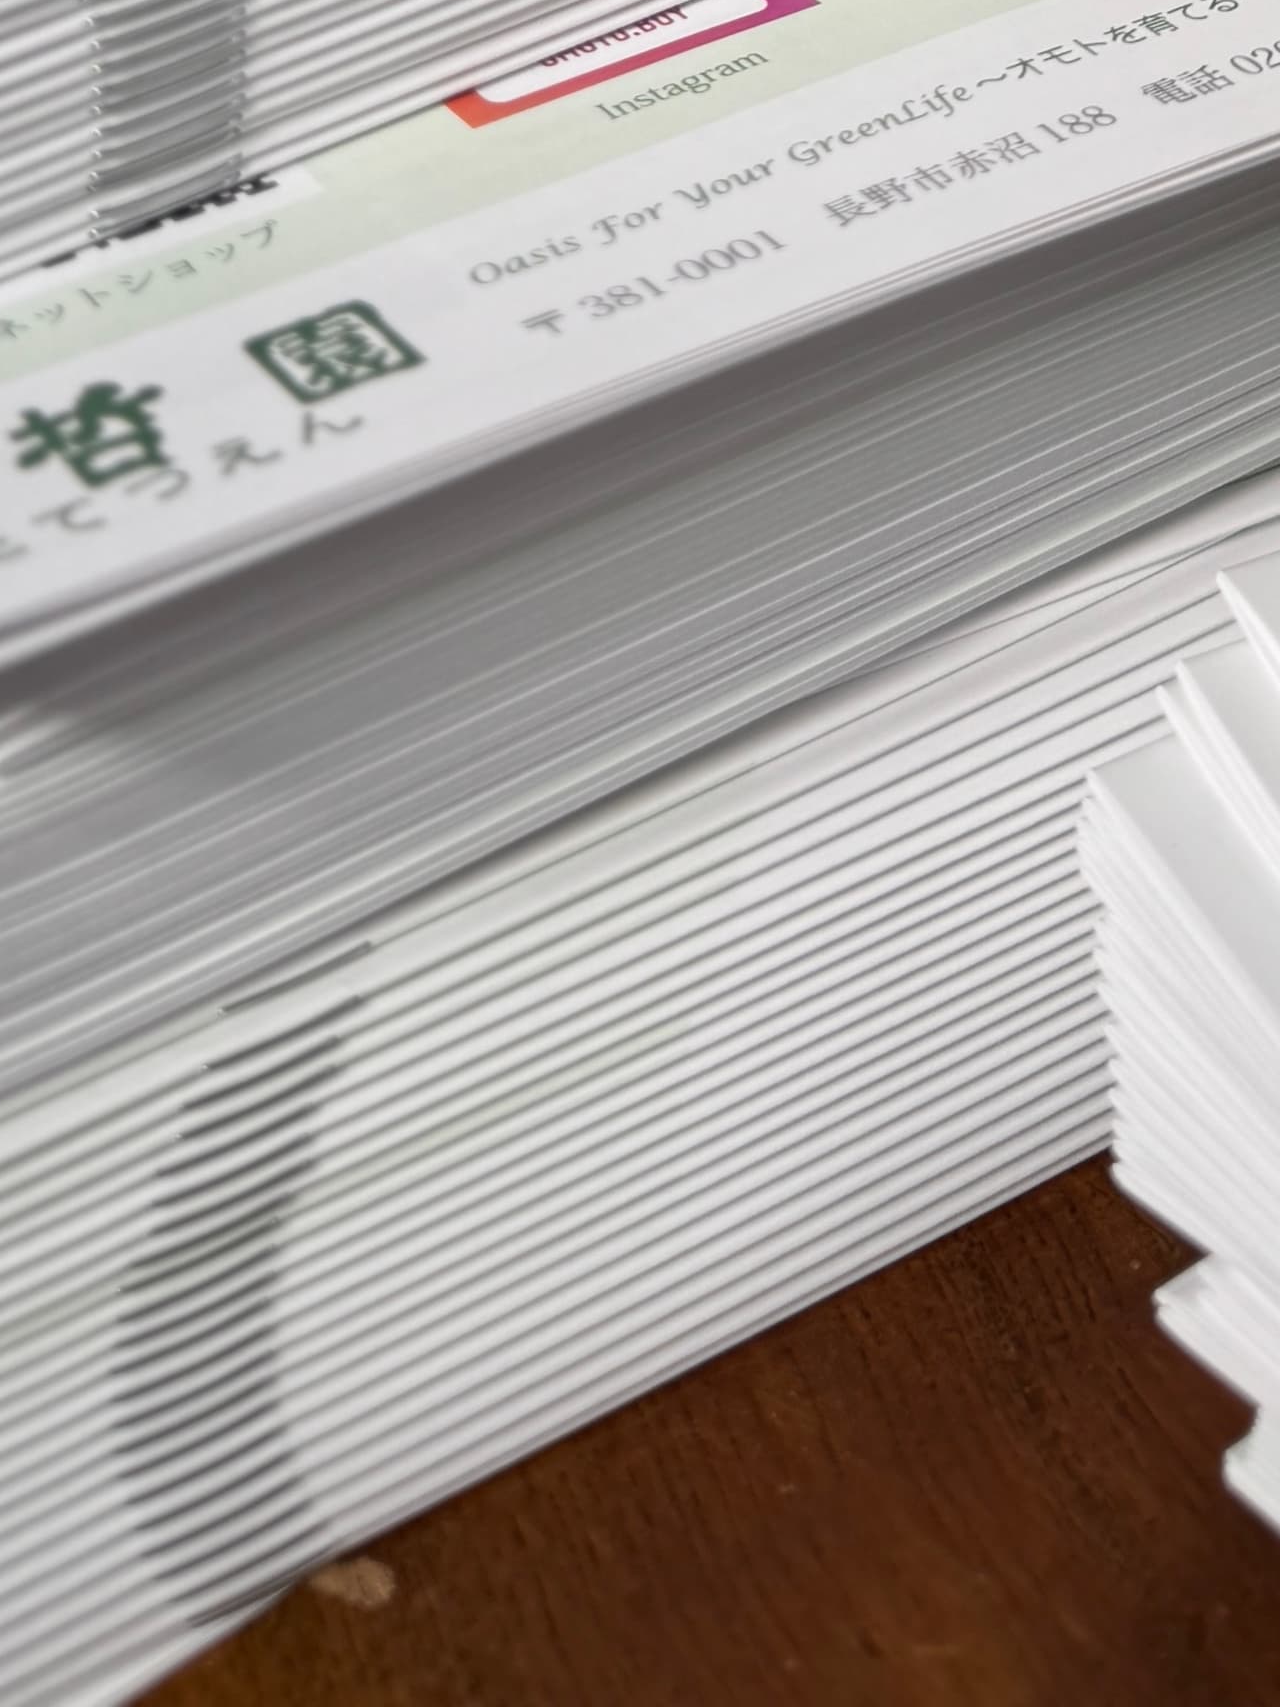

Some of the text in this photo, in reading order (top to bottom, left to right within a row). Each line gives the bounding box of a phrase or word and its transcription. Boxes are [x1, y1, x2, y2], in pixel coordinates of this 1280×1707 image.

[597, 50, 770, 121] Instagram
[468, 230, 583, 289] Oasis
[590, 199, 666, 249] For
[672, 154, 777, 211] Your
